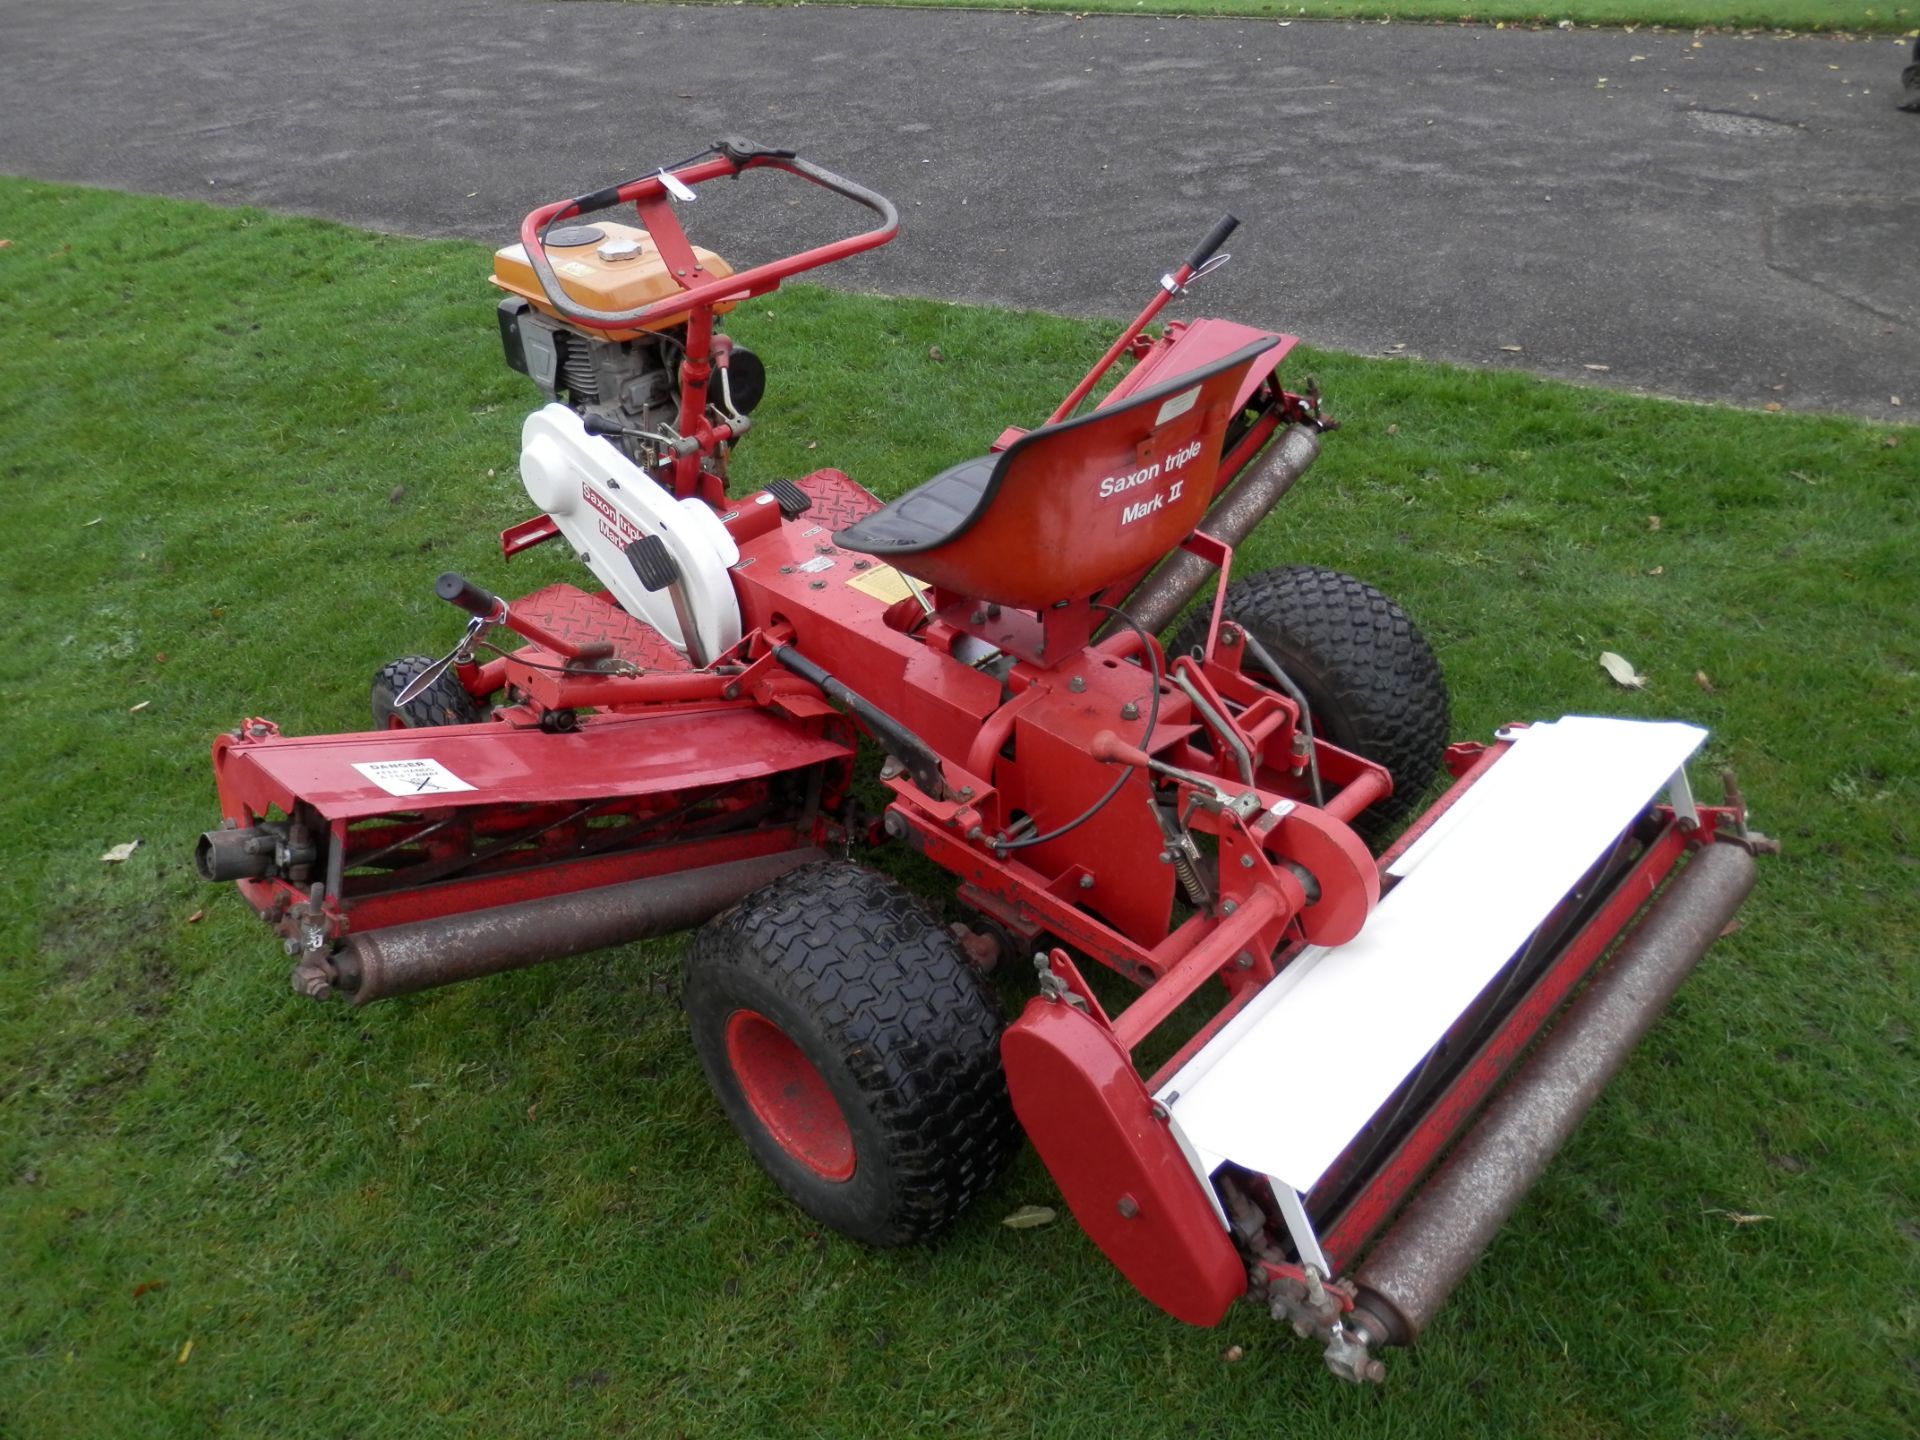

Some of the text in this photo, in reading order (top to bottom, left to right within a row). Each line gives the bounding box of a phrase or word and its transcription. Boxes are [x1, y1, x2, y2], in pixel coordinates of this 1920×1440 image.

[1099, 441, 1201, 498] Saxon triple
[583, 483, 617, 522] Saxon
[1121, 480, 1184, 525] Mark II
[600, 520, 625, 551] Mark
[369, 761, 426, 770] DANGER
